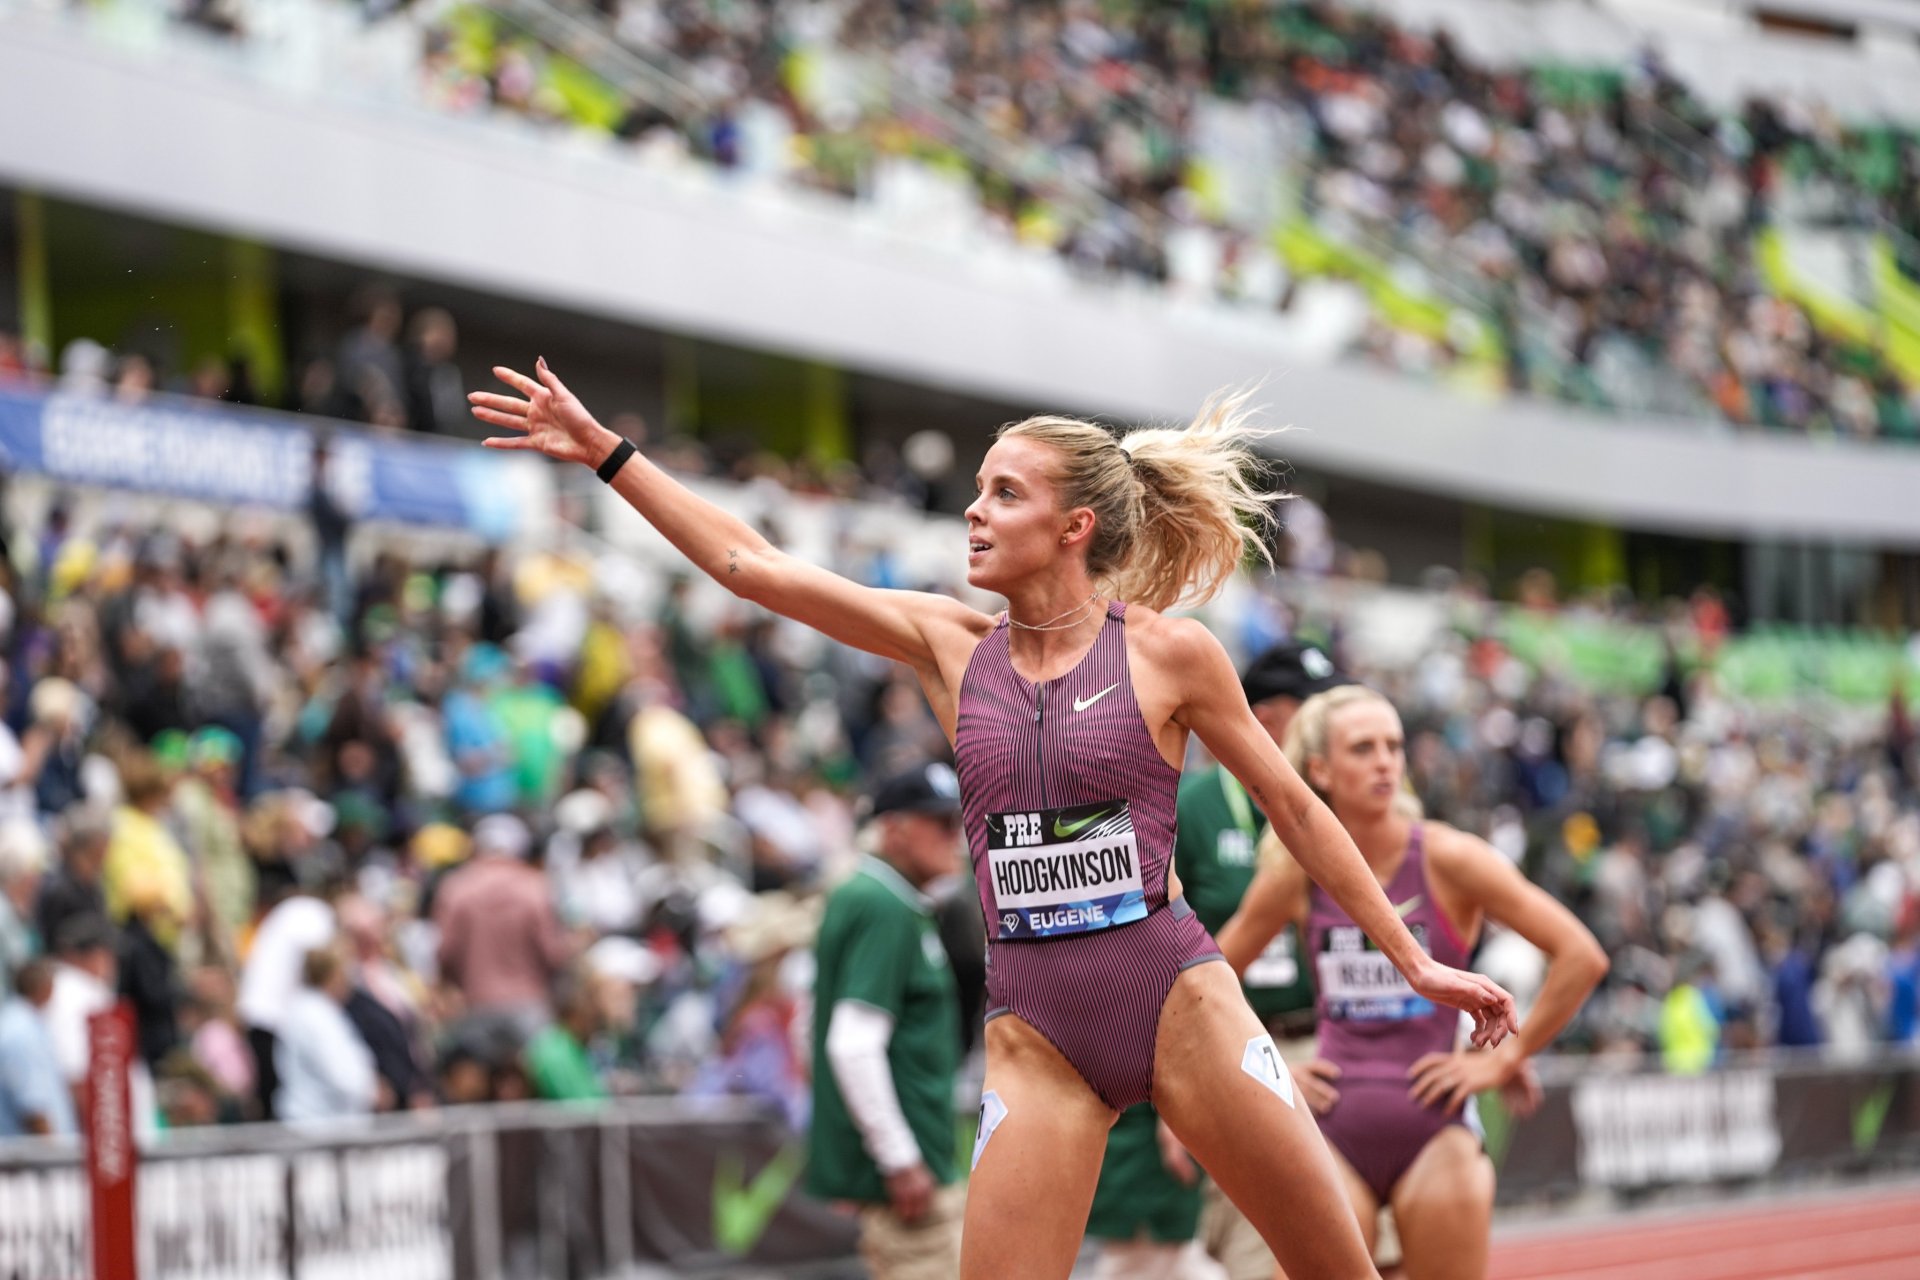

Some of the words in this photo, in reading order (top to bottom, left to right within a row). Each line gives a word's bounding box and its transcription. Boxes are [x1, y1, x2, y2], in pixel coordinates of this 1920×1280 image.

[1003, 813, 1043, 847] PRE
[995, 844, 1133, 896] HODGKINSON
[1029, 905, 1105, 930] EUGENE
[1263, 1045, 1280, 1080] 7
